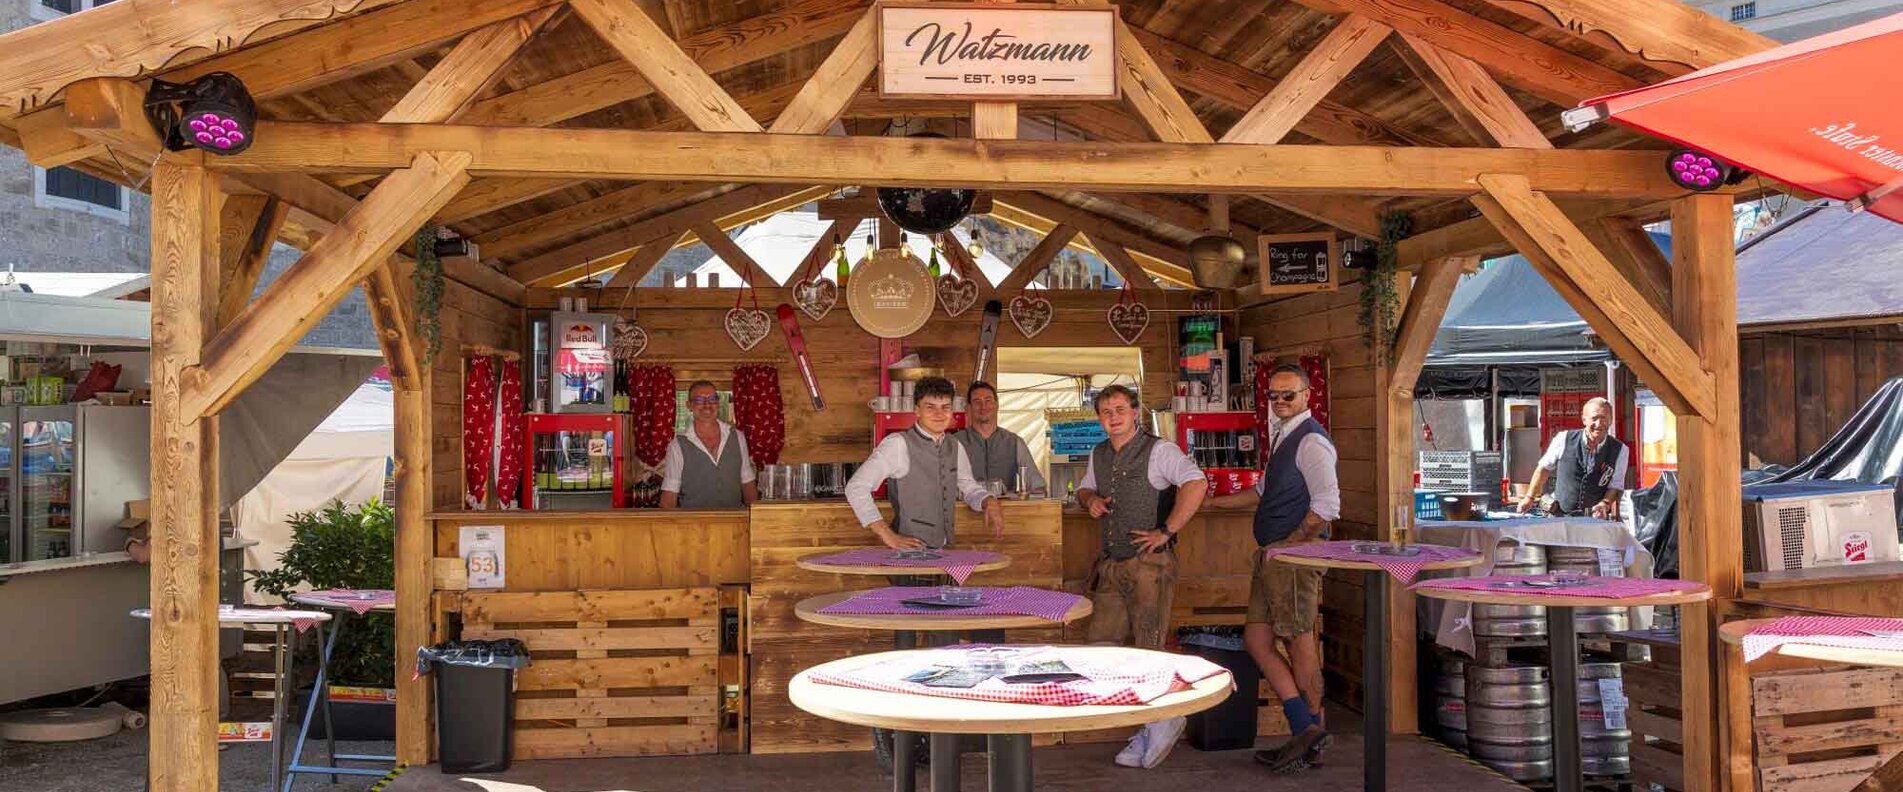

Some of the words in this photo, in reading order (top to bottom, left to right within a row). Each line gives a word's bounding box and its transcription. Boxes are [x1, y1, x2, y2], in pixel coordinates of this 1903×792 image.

[905, 20, 1093, 66] Watzmann
[964, 73, 995, 84] EST.
[1001, 74, 1037, 85] 1993
[1270, 248, 1289, 263] Ring
[1291, 247, 1308, 259] for
[566, 334, 581, 342] Red
[582, 334, 597, 342] Bull
[471, 557, 493, 573] 53
